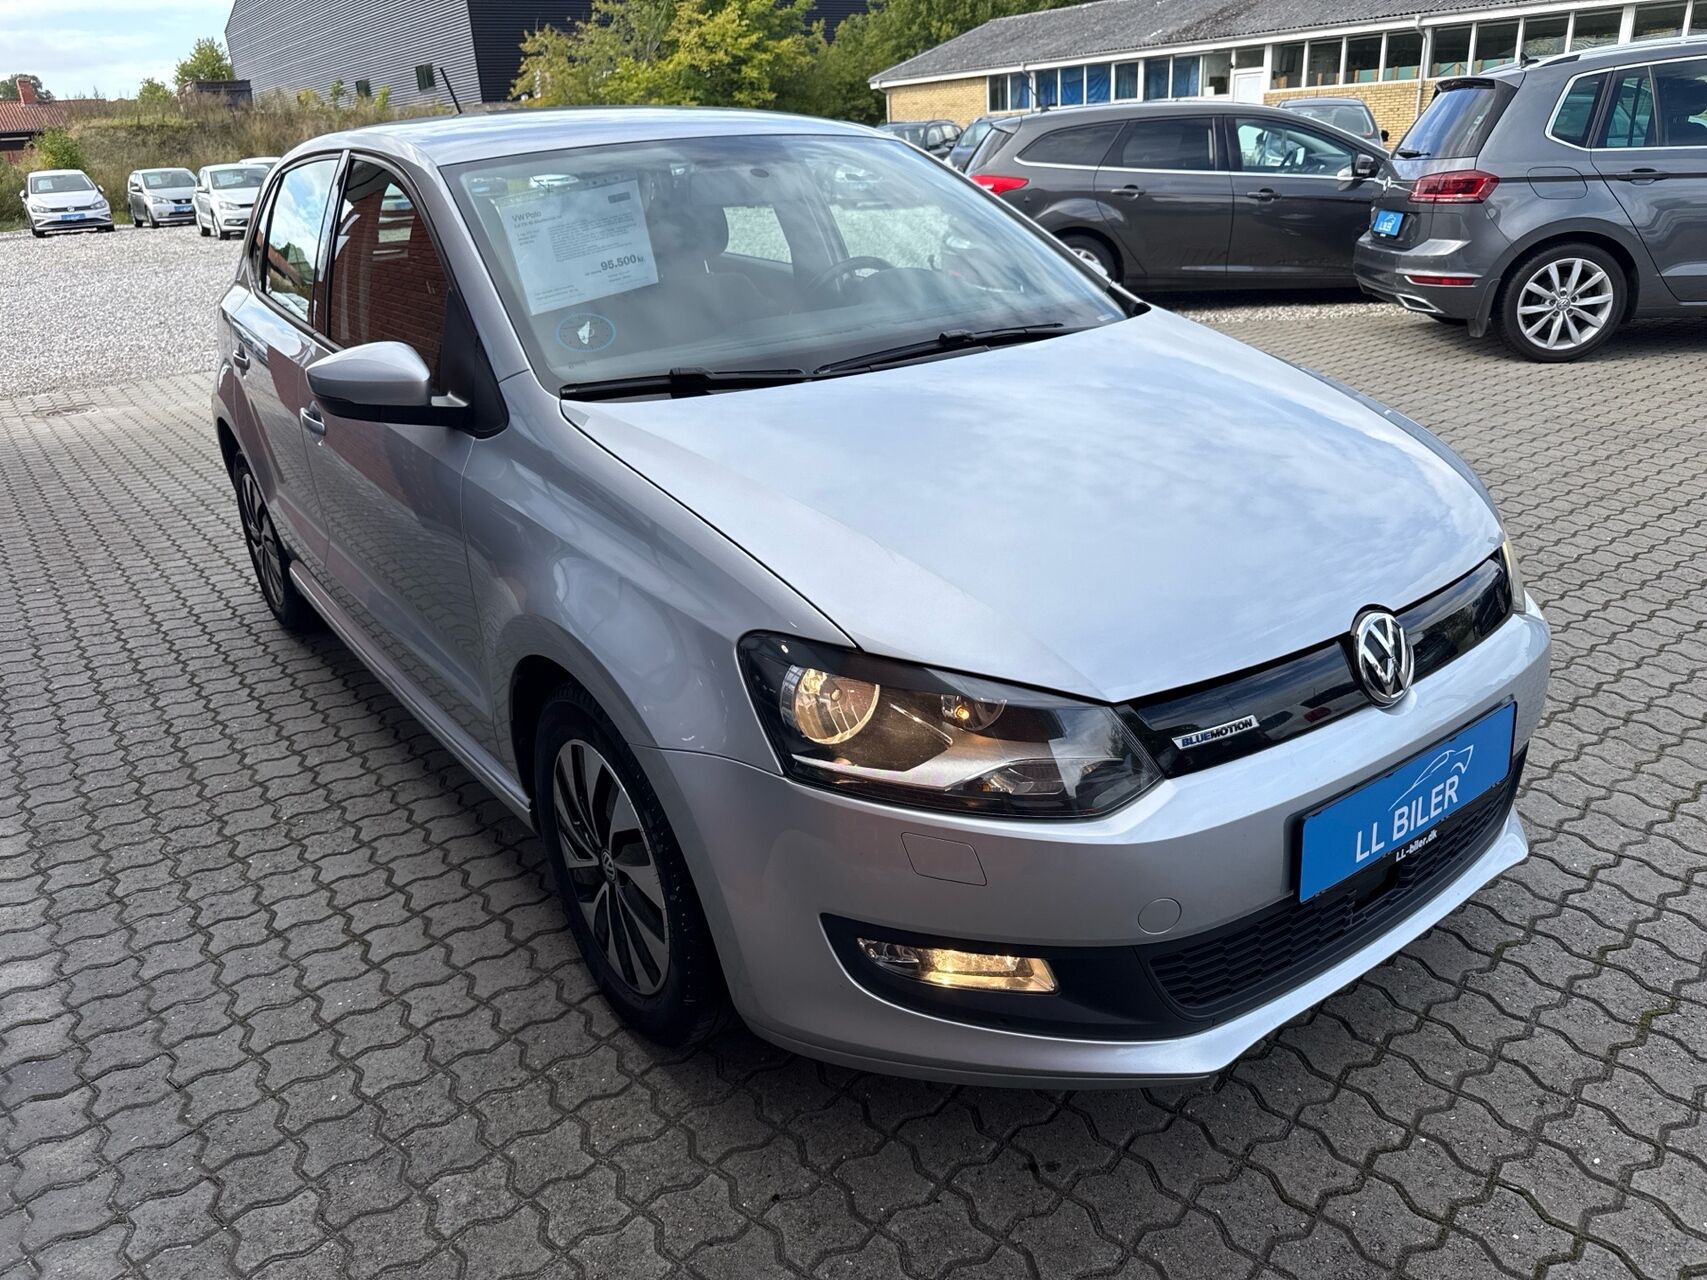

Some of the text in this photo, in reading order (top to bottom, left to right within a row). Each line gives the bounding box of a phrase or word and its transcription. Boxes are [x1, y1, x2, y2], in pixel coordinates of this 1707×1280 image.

[600, 254, 636, 271] 95.500
[1181, 718, 1253, 747] BLUEMOTION
[1356, 775, 1459, 863] LL BILER
[1395, 830, 1437, 862] LL-biler.dk
